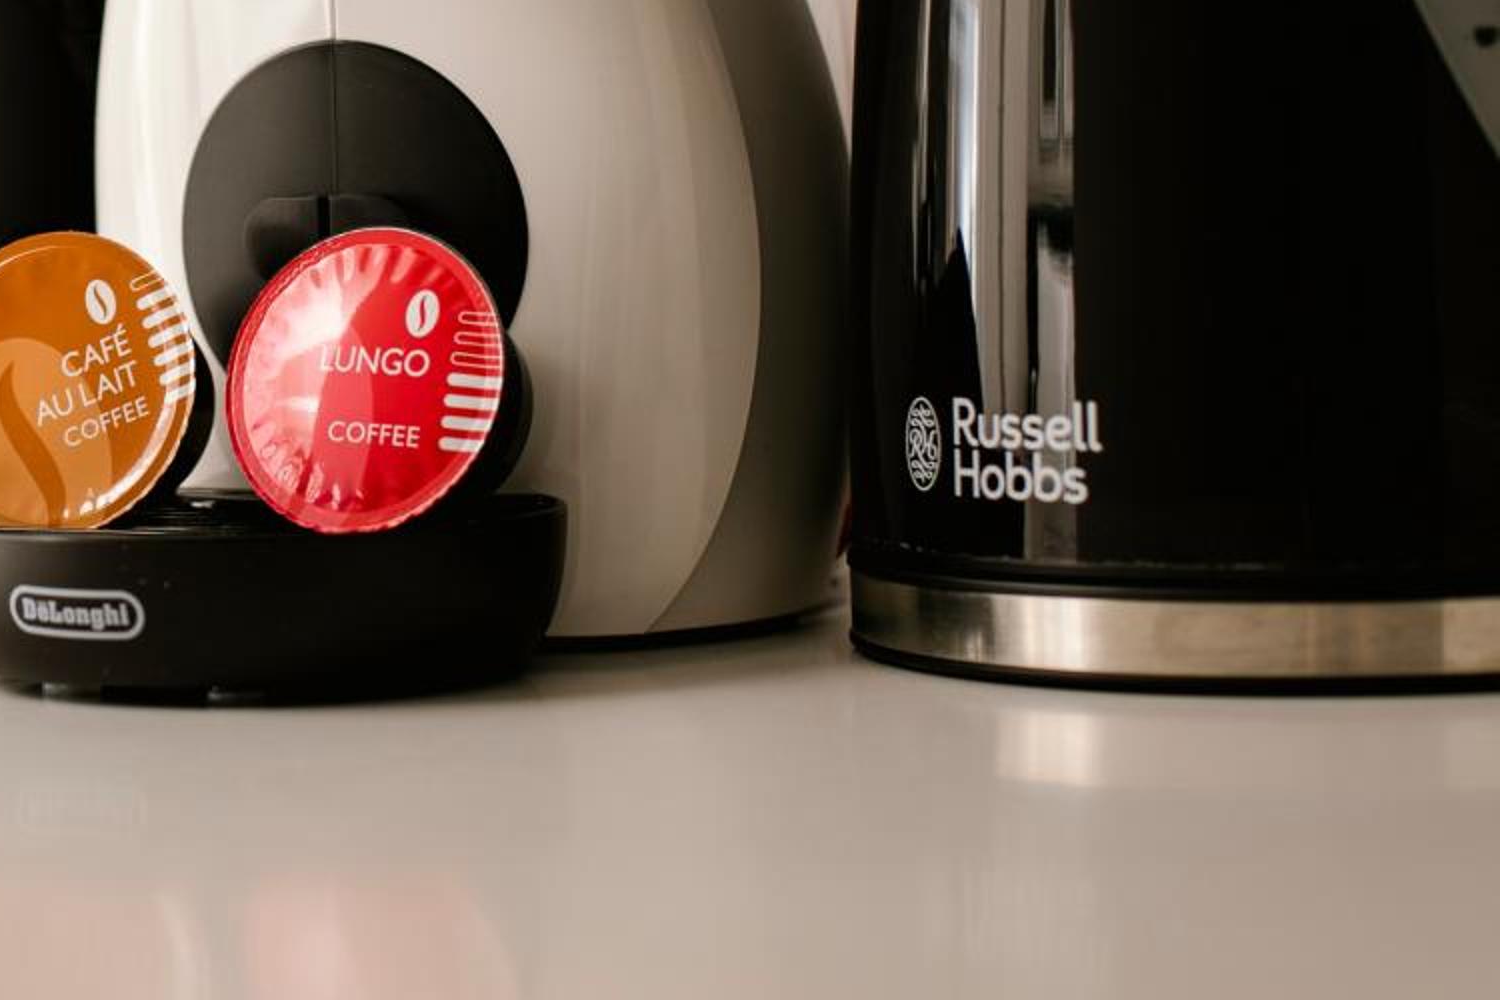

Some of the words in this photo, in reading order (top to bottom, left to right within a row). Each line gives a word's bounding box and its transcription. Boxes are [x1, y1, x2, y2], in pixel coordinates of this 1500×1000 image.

[61, 323, 133, 378] CAFÉ
[317, 345, 431, 378] LUNGO
[36, 389, 73, 426] AU
[79, 360, 137, 408] LAIT
[63, 396, 150, 447] COFFEE
[327, 420, 420, 449] COFFEE
[952, 397, 1103, 452] Russell
[953, 448, 1090, 505] Hobbs
